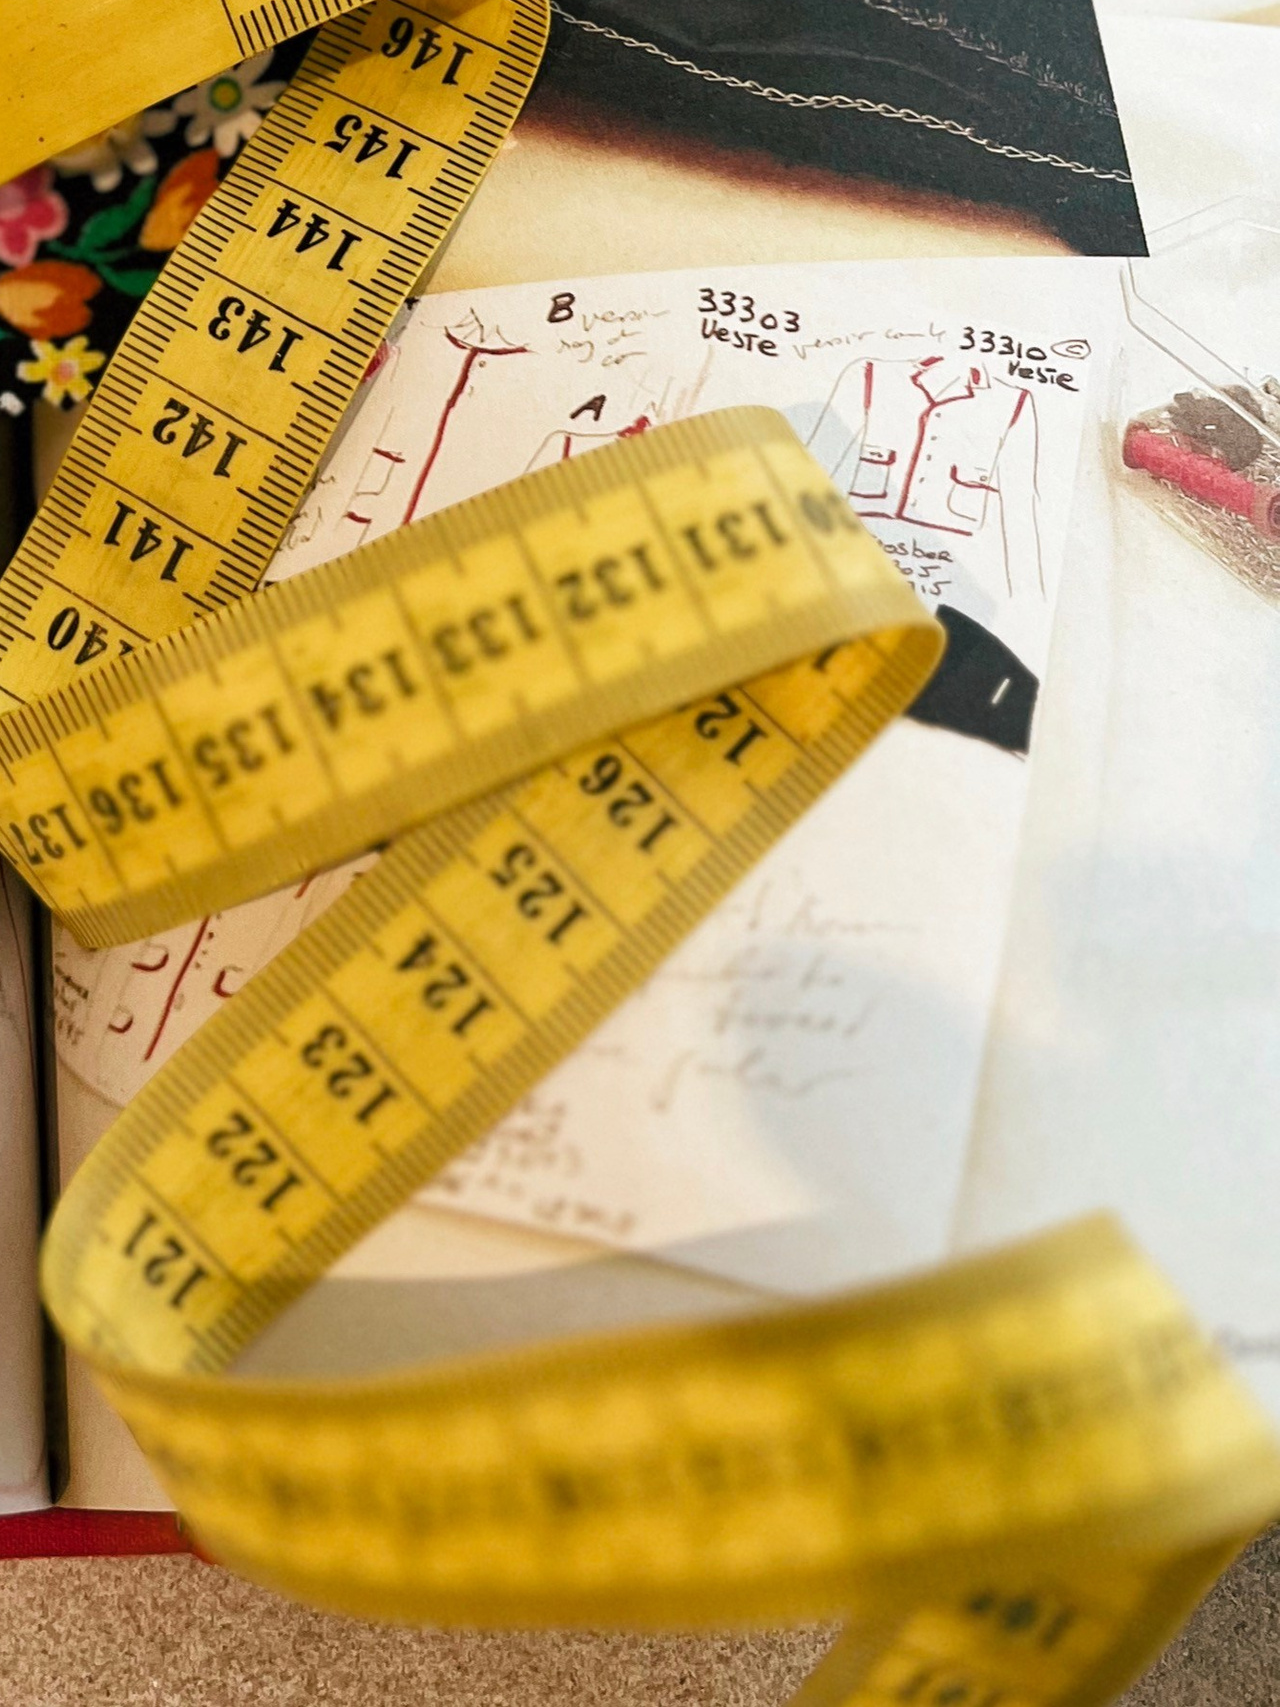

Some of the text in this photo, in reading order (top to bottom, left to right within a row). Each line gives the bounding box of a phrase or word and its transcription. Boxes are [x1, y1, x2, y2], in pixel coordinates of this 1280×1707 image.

[381, 16, 474, 86] 146
[324, 113, 421, 179] 145
[266, 198, 362, 271] 144
[207, 296, 303, 373] 143
[547, 292, 575, 323] B
[698, 287, 800, 332] 33303
[959, 326, 1047, 360] 33310
[152, 397, 247, 478] 142
[570, 394, 607, 421] A
[103, 500, 194, 582] 141
[681, 502, 788, 571] 131
[556, 544, 668, 624] 132
[47, 606, 132, 665] 40
[432, 595, 543, 675] 133
[310, 647, 419, 733] 134
[675, 690, 769, 768] 12
[193, 702, 295, 787] 135
[8, 803, 87, 865] 137
[88, 760, 181, 835] 136
[578, 753, 681, 854] 126
[489, 841, 590, 945] 125
[395, 933, 498, 1037] 124
[301, 1023, 401, 1126] 123
[206, 1110, 305, 1212] 122
[121, 1213, 211, 1310] 121
